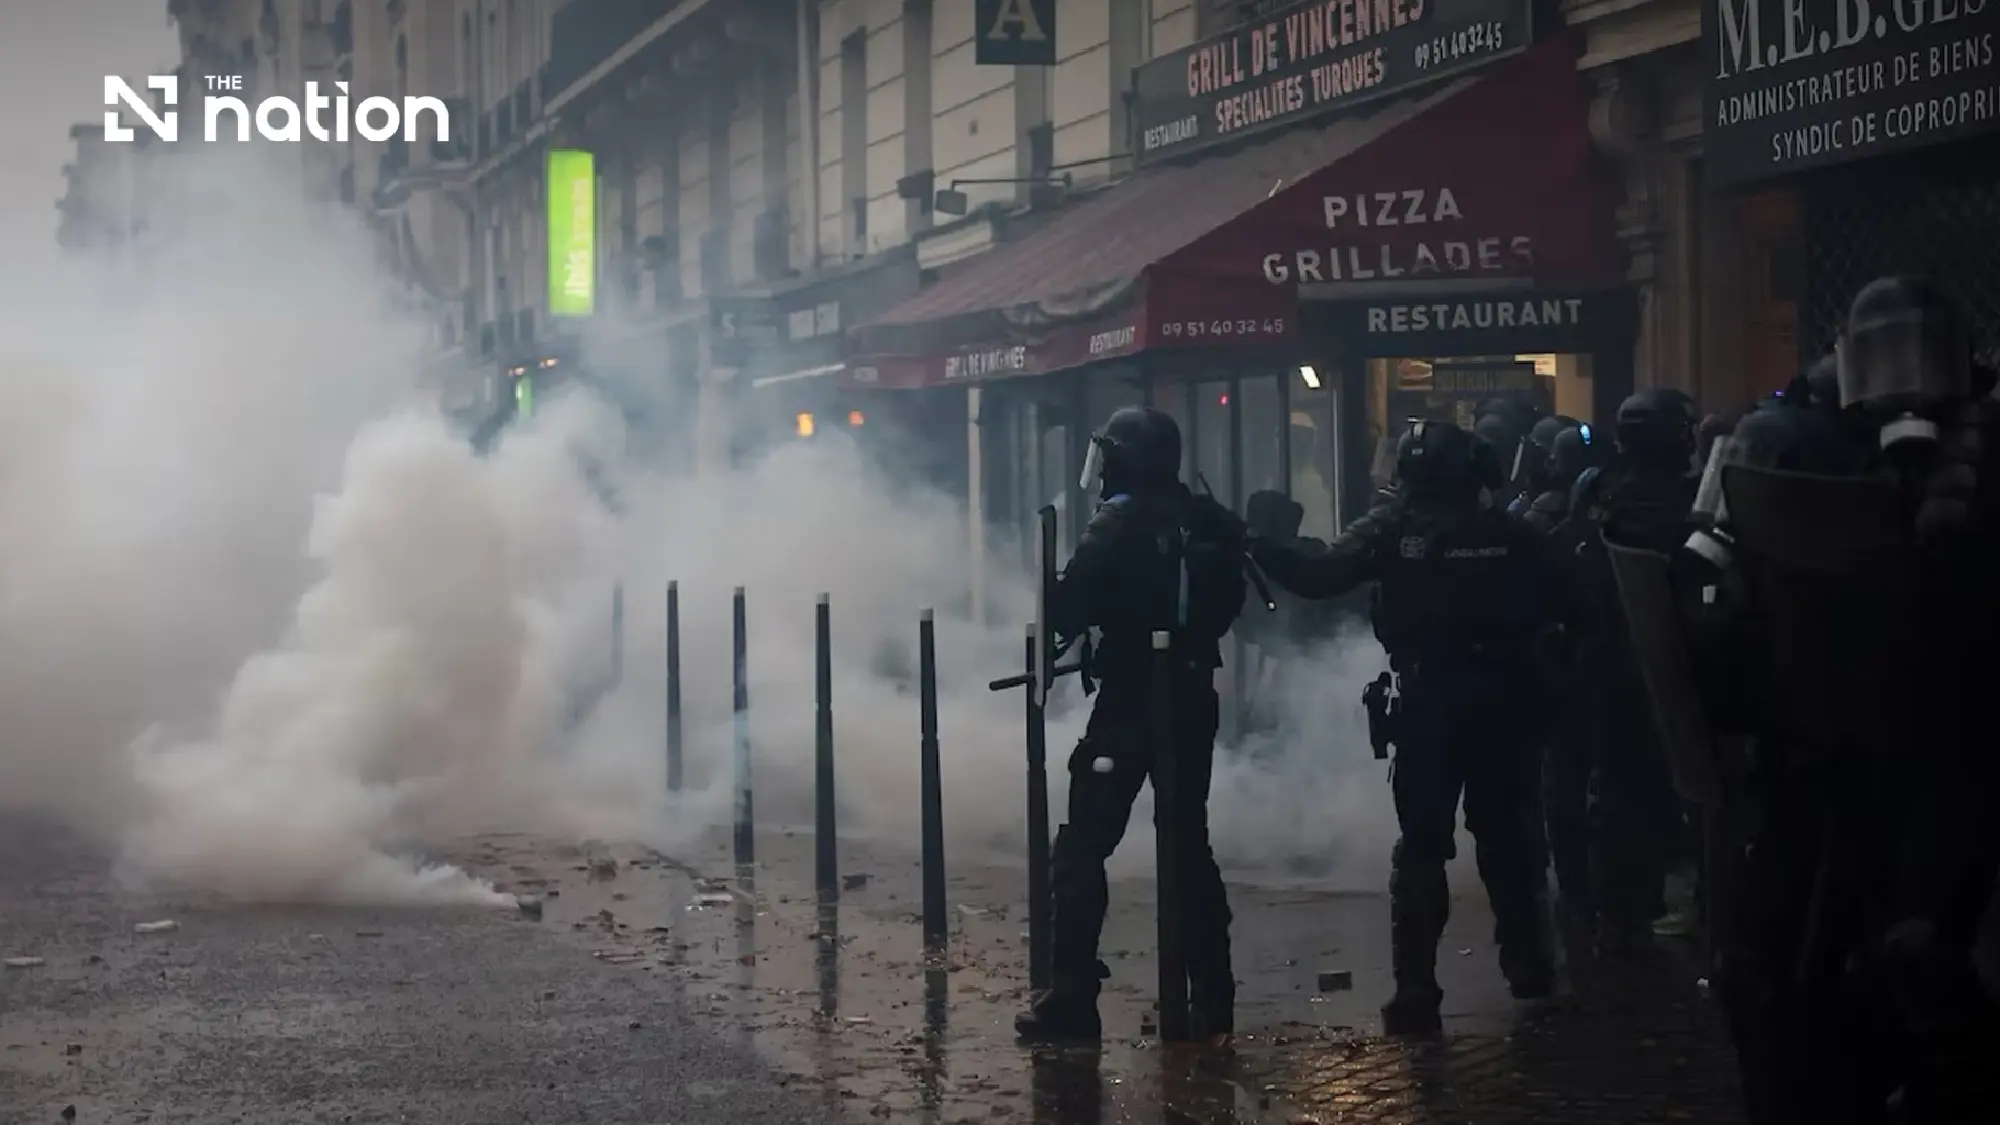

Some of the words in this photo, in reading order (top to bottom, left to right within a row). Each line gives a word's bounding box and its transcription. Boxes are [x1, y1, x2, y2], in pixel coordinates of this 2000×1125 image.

[1187, 37, 1244, 97] GRILL
[1252, 23, 1278, 75] DE
[1414, 44, 1430, 69] 09
[1433, 38, 1447, 65] 51
[1215, 75, 1303, 133] SPECIALITES
[1311, 48, 1385, 102] TURQUES
[1718, 61, 1885, 127] ADMINISTRATEUR
[1894, 52, 1920, 87] DE
[1930, 33, 1993, 78] BIENS
[1772, 120, 1843, 161] SYNDIC
[1852, 112, 1876, 146] DE
[1885, 86, 2000, 137] COPROPRI
[1323, 188, 1463, 229] PIZZA
[1262, 237, 1534, 284] GRILLADES
[1162, 322, 1182, 337] 09
[1187, 321, 1205, 337] 51
[1210, 319, 1232, 336] 40
[1236, 319, 1256, 335] 32
[1263, 318, 1284, 334] 45
[1368, 299, 1582, 333] RESTAURANT
